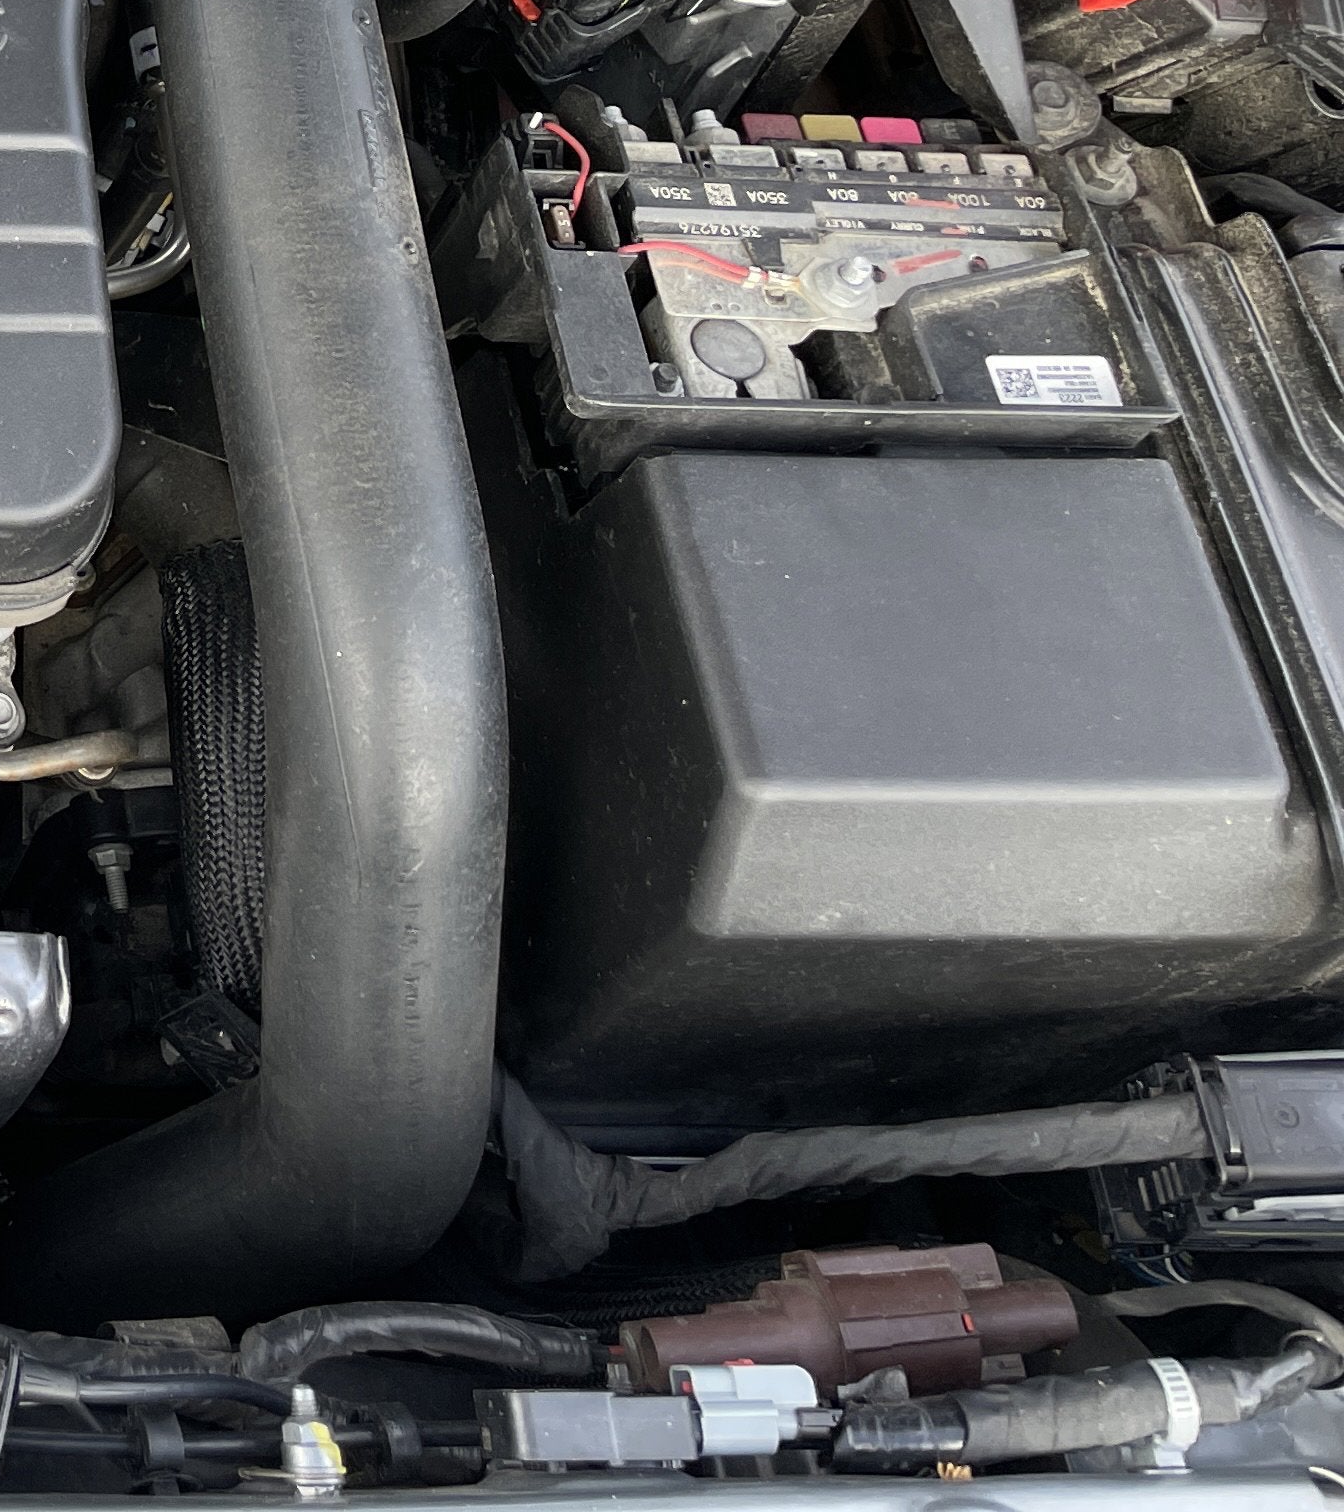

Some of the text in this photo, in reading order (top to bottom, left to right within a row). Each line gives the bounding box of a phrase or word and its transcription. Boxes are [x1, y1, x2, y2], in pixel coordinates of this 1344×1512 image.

[649, 186, 692, 200] 350A
[746, 190, 789, 205] 350A
[826, 188, 859, 202] 80A
[947, 192, 991, 207] 100A
[1014, 194, 1045, 209] 60A
[679, 221, 763, 239] 35194276
